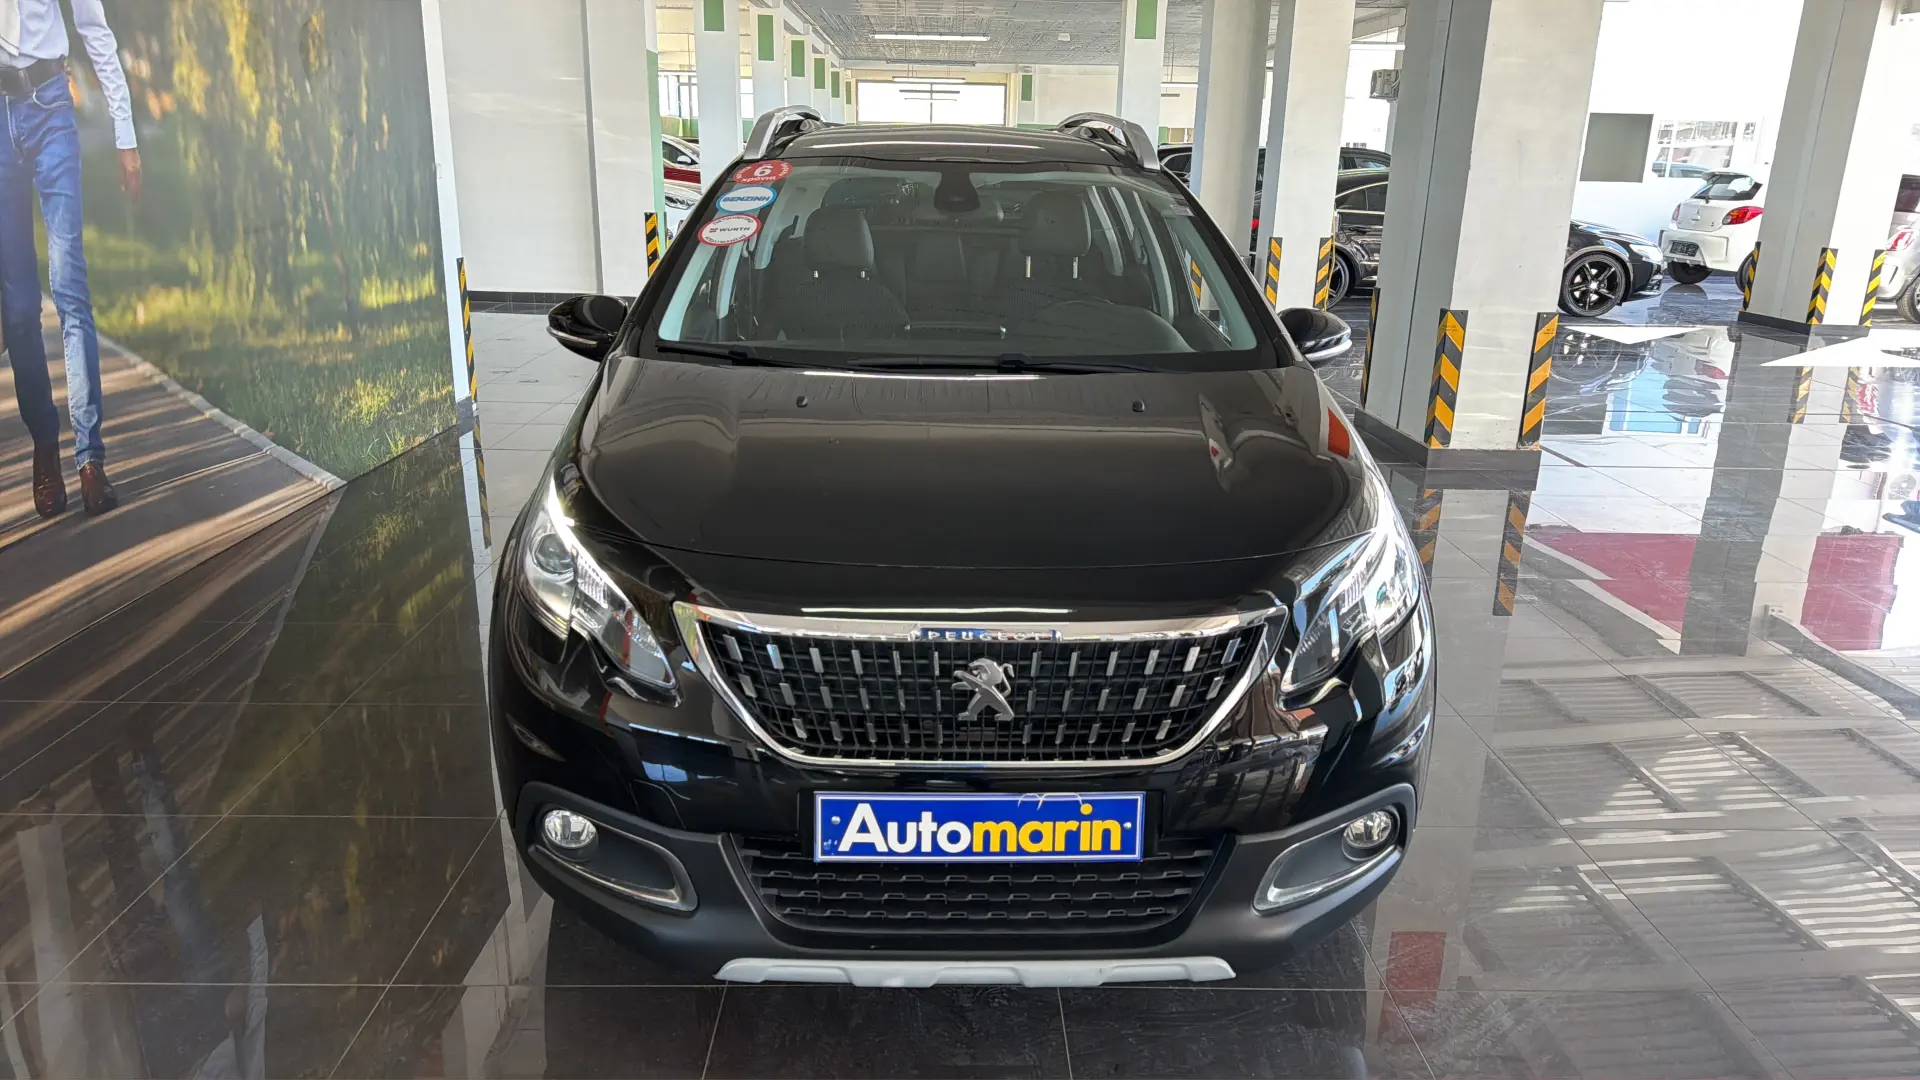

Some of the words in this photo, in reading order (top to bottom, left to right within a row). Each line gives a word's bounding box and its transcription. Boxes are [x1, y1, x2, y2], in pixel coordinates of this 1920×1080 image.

[753, 165, 774, 177] 6
[927, 630, 1042, 641] PEUGEOT
[837, 802, 1121, 853] Automarin
